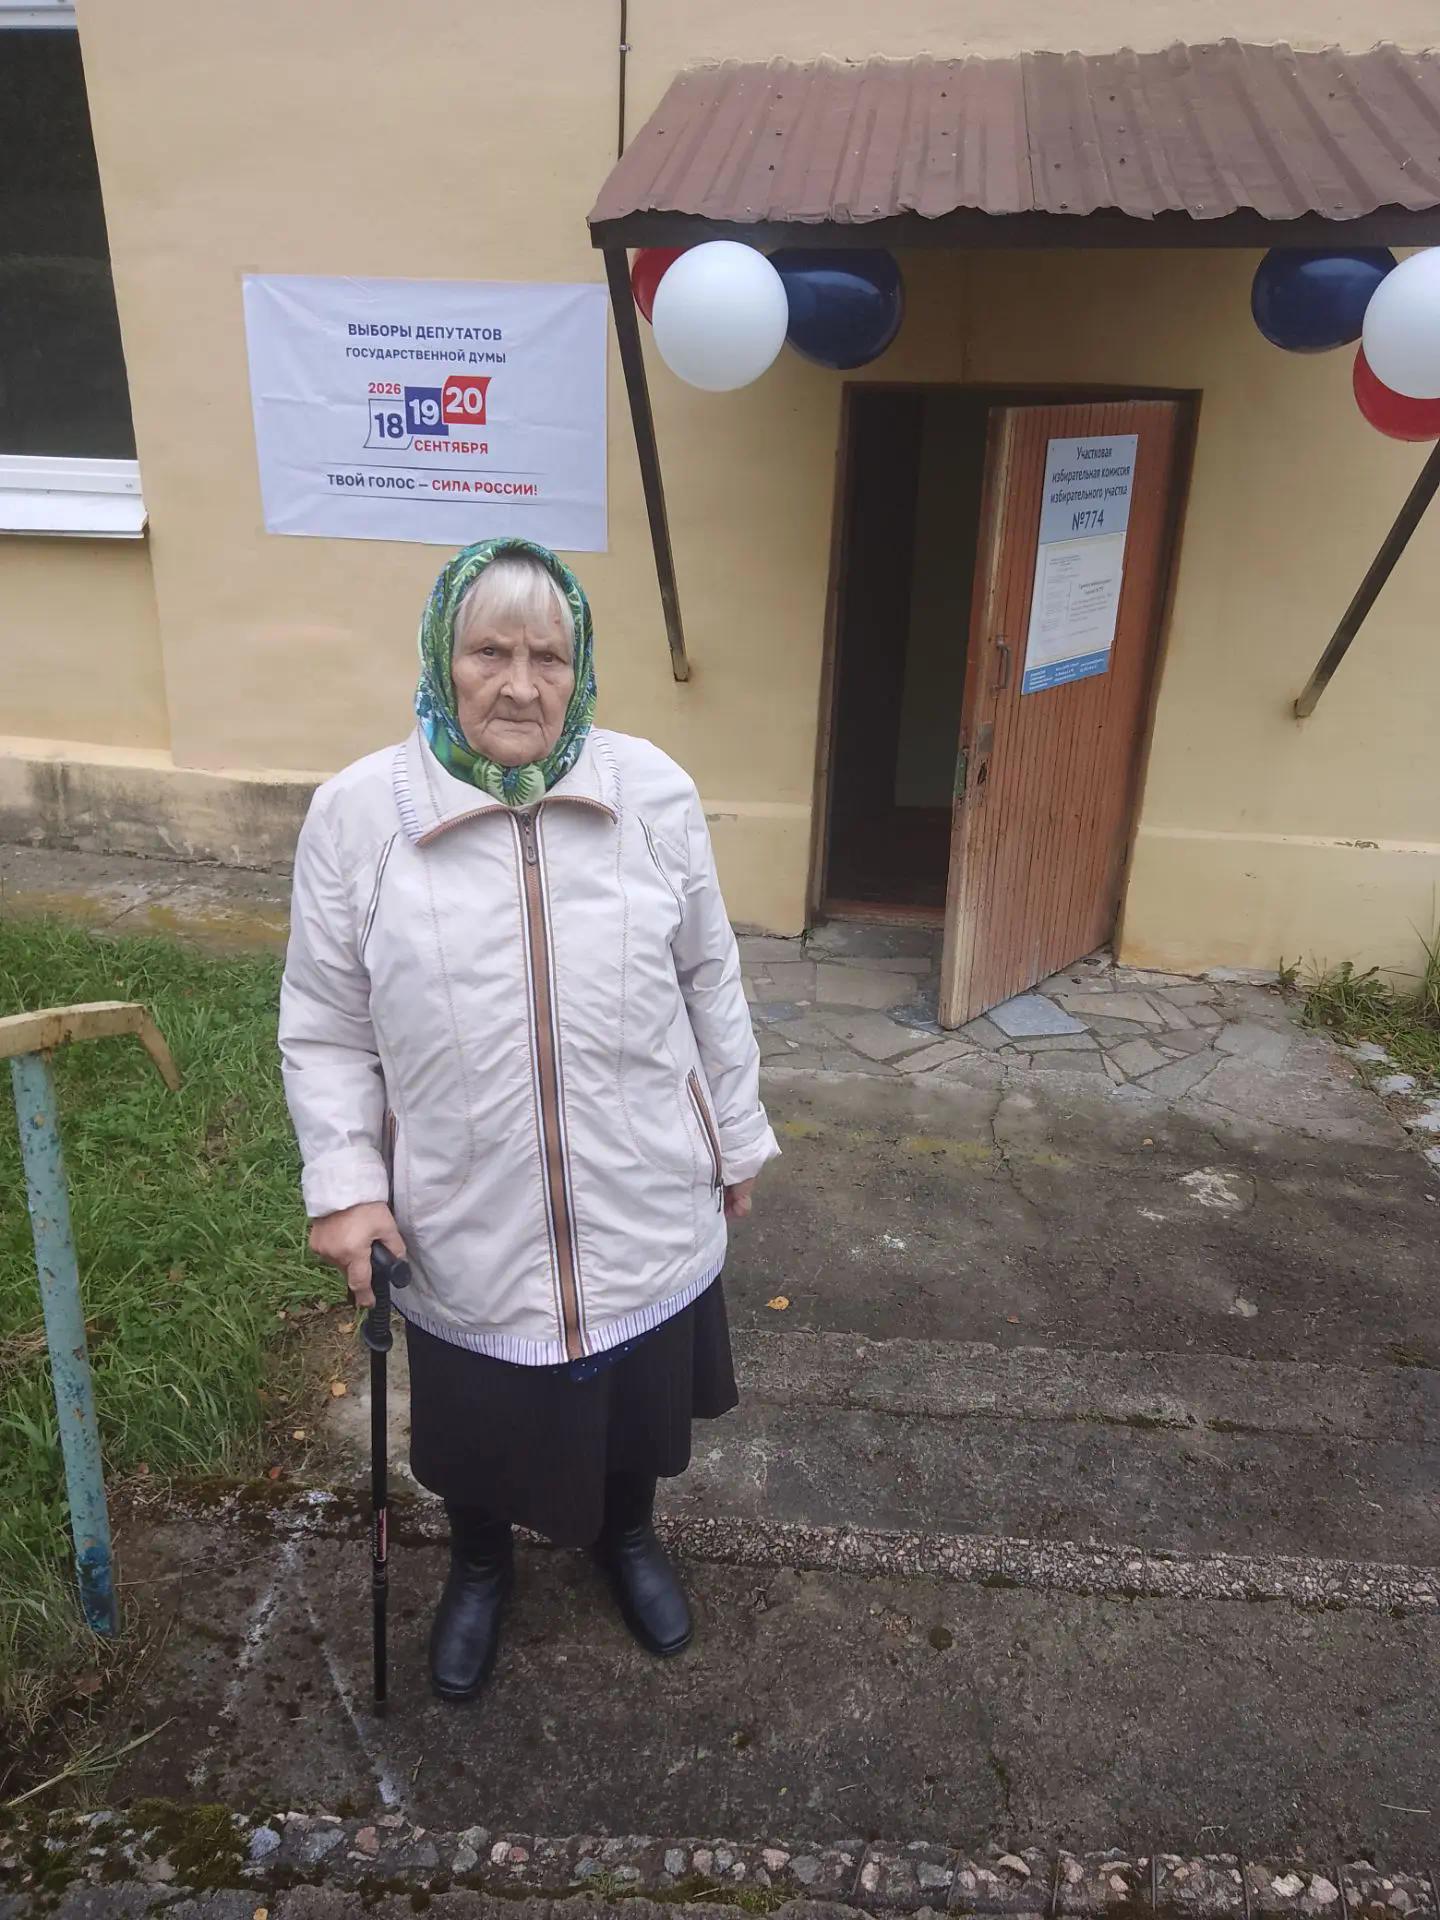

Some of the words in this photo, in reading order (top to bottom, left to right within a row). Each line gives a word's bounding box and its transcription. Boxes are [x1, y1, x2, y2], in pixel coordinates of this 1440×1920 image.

[348, 323, 412, 338] ВЫБОРЫ
[416, 326, 502, 341] ДЕПУТАТОВ
[346, 347, 466, 362] ГОСУДАРСТВЕННОЙ
[469, 352, 506, 364] ДУМЫ
[368, 382, 401, 395] 2026
[374, 412, 404, 439] 18
[408, 398, 440, 426] 19
[445, 386, 483, 415] 20
[414, 440, 488, 454] СЕНТЯБРЯ
[1076, 446, 1113, 460] Участковая
[1052, 469, 1101, 484] избирательная
[1101, 465, 1131, 478] комиссия
[327, 472, 365, 487] ТВОЙ
[368, 476, 415, 490] ГОЛОС
[432, 480, 471, 493] СИЛА
[474, 481, 538, 496] РОССИИ!
[1050, 489, 1103, 505] избирательного
[1104, 485, 1128, 501] участка
[1072, 509, 1104, 531] №774
